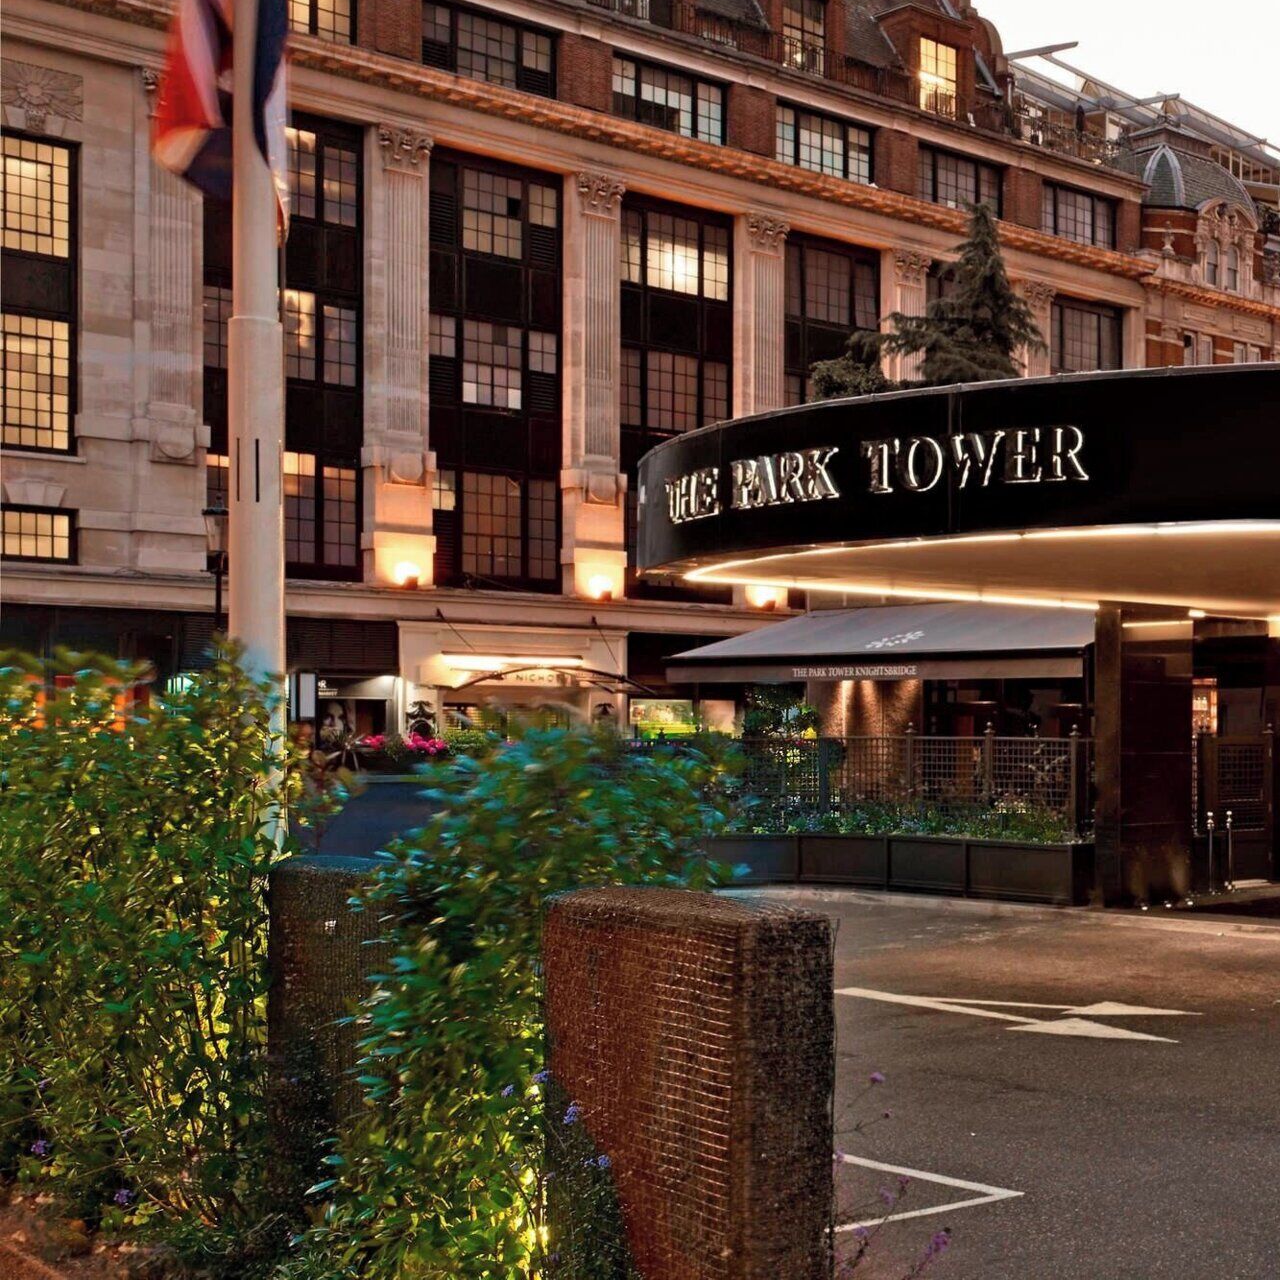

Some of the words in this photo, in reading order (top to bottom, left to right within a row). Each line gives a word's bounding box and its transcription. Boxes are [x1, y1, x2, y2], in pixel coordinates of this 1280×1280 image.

[664, 468, 720, 524] THE
[730, 446, 840, 509] PARK
[861, 426, 1089, 493] TOWER
[792, 668, 807, 677] THE
[808, 667, 826, 677] PARK
[828, 666, 854, 676] TOWER
[855, 665, 917, 676] KNIGHTSBRIDGE
